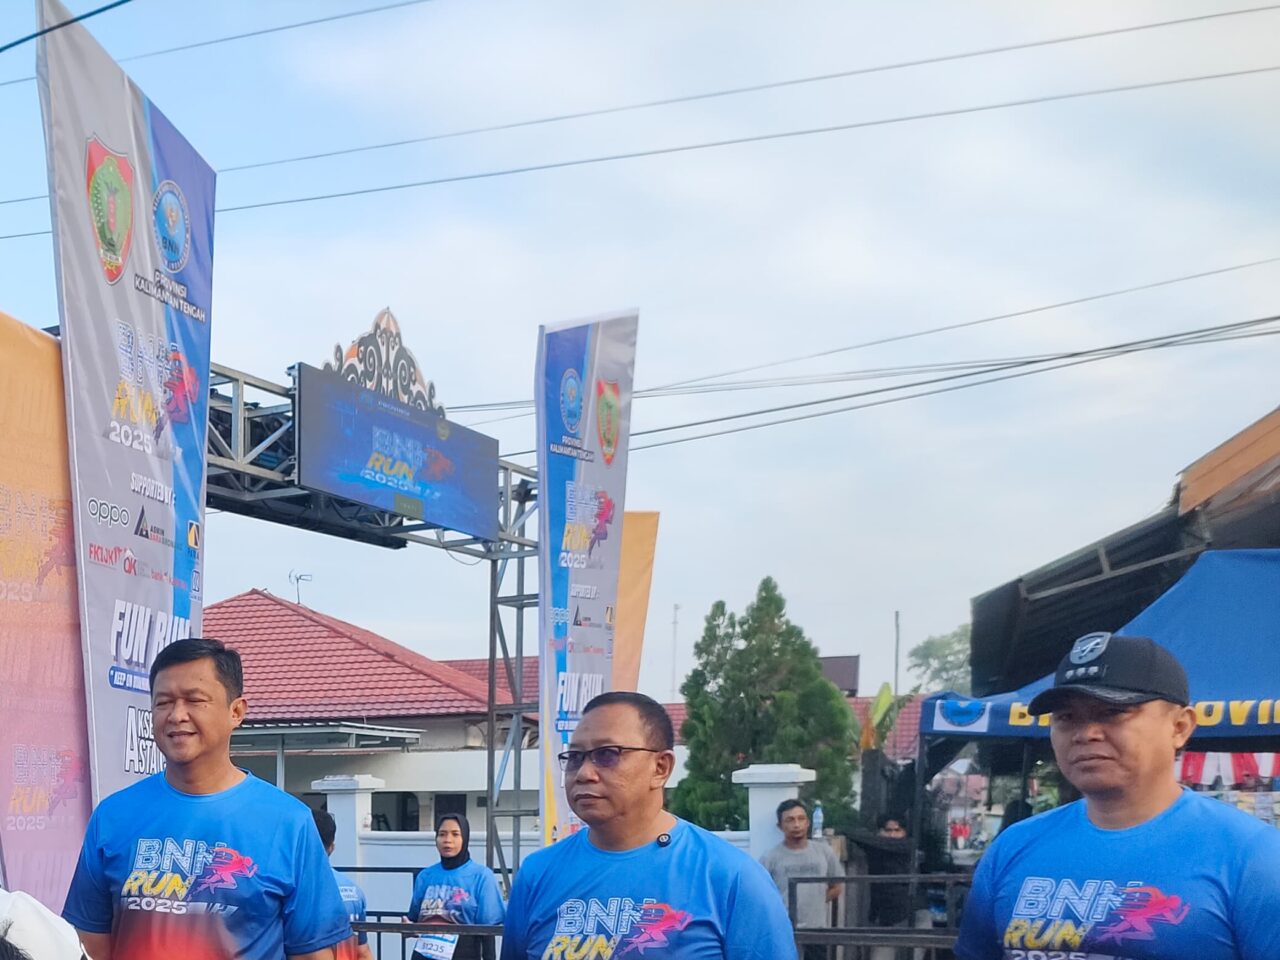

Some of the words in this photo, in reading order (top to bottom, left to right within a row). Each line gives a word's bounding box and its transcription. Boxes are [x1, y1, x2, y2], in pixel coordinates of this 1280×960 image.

[134, 274, 179, 309] KALIMANTAN
[179, 299, 206, 322] TENGAH
[154, 269, 188, 299] PROVINSI
[108, 420, 154, 455] 2025
[366, 450, 416, 480] RUN
[130, 472, 164, 504] SUPPORTED
[88, 499, 130, 528] oppo
[559, 552, 588, 569] 2025
[111, 599, 152, 663] FUN
[557, 671, 581, 713] FUN
[5, 815, 48, 833] 2025
[120, 870, 196, 901] RUN
[127, 896, 187, 915] 2025
[1003, 918, 1087, 949] RUN
